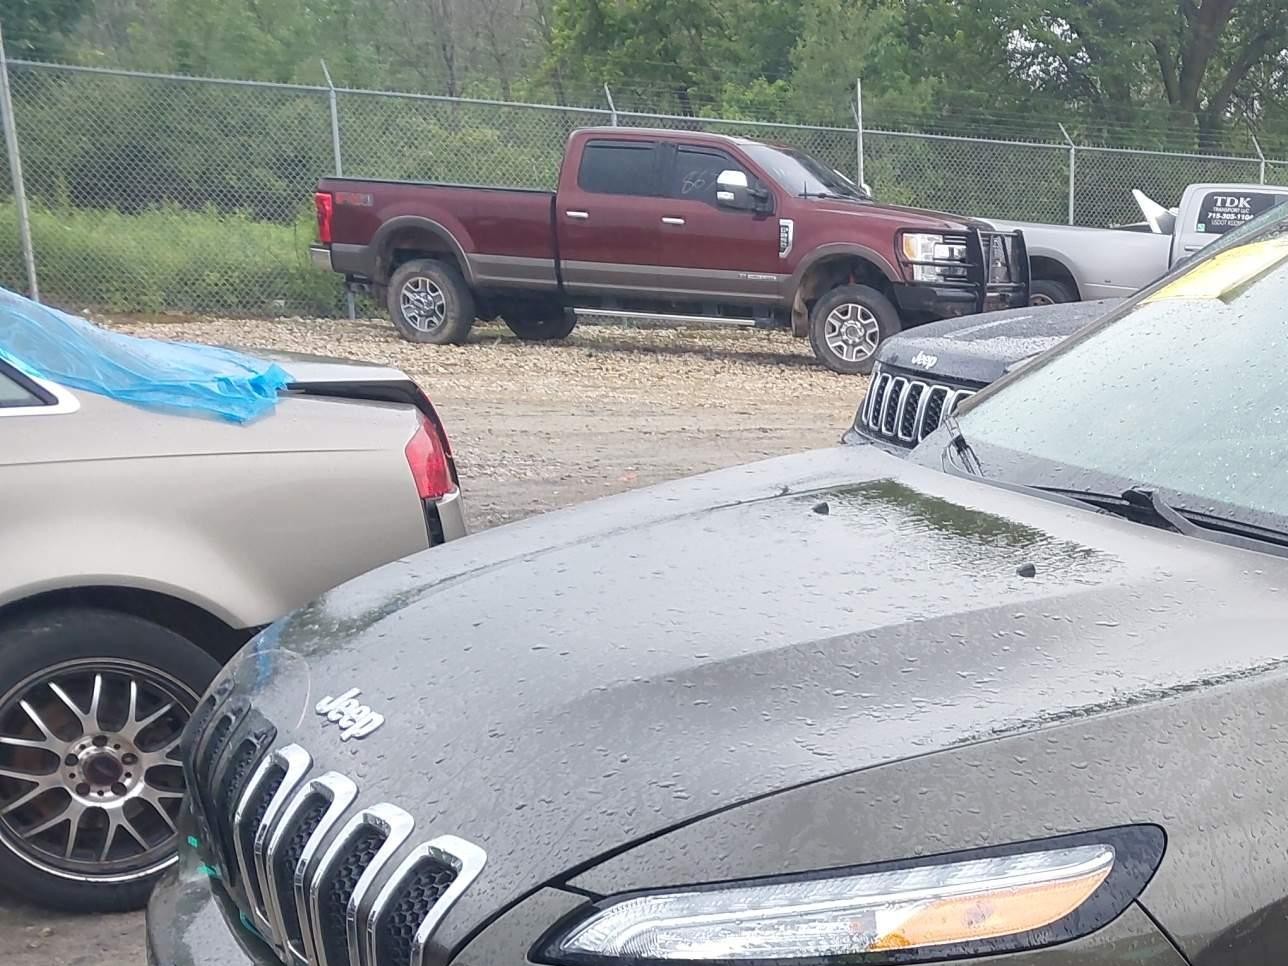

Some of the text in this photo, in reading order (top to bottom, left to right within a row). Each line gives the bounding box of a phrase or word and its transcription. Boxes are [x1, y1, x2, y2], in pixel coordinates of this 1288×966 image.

[1213, 196, 1251, 208] TDK
[911, 350, 938, 370] Jeep
[315, 687, 385, 742] Jeep
